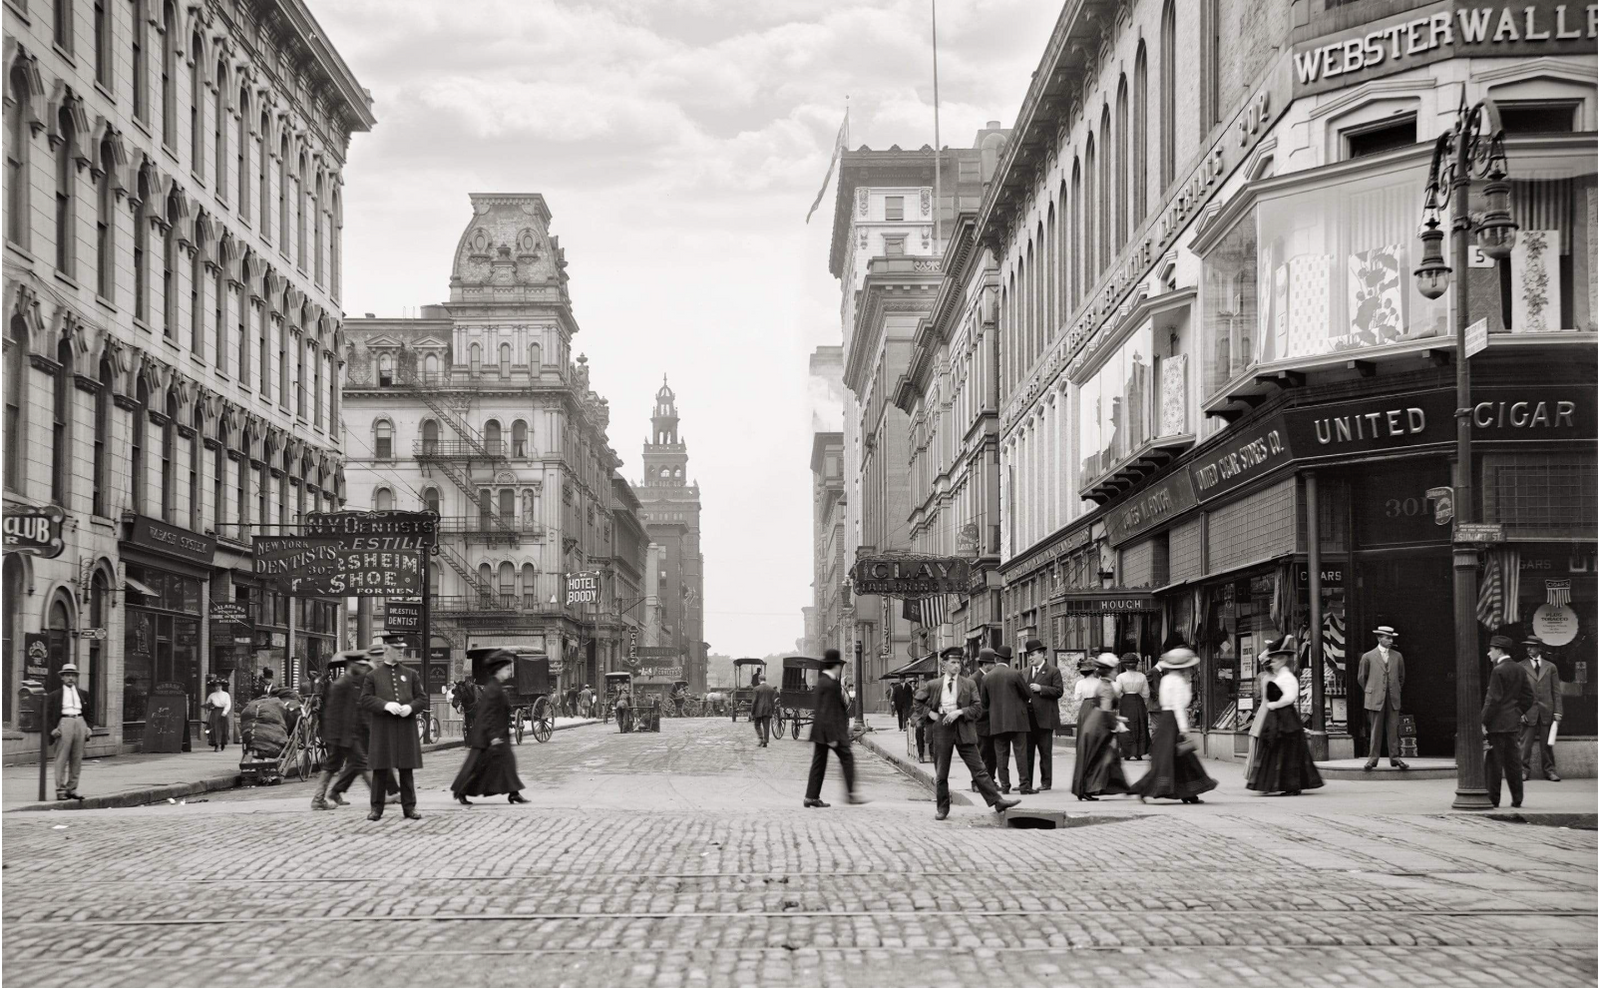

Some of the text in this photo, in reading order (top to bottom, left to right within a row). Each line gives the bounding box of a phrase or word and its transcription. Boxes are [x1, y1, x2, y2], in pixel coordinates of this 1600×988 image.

[1294, 10, 1453, 84] WEBSTER
[1239, 91, 1270, 147] 302
[1314, 401, 1576, 444] UNITED CIGAR
[1195, 430, 1285, 491] UNITED CIGAR STORES CO.
[3, 517, 50, 543] CLUB
[344, 517, 435, 534] DENTISTS
[352, 537, 425, 550] ESTILL
[1457, 532, 1487, 542] SUMMIT
[257, 539, 310, 556] NEW YORK
[256, 545, 337, 575] DENTISTS
[308, 566, 334, 575] 307
[871, 562, 954, 579] CLAY
[1300, 571, 1342, 581] CARS
[328, 571, 398, 593] SHOE
[568, 577, 596, 590] HOTEL
[862, 582, 939, 592] TAILORING
[568, 591, 597, 603] BOODY
[1101, 599, 1141, 610] HOUGH
[388, 617, 418, 626] DENTIST
